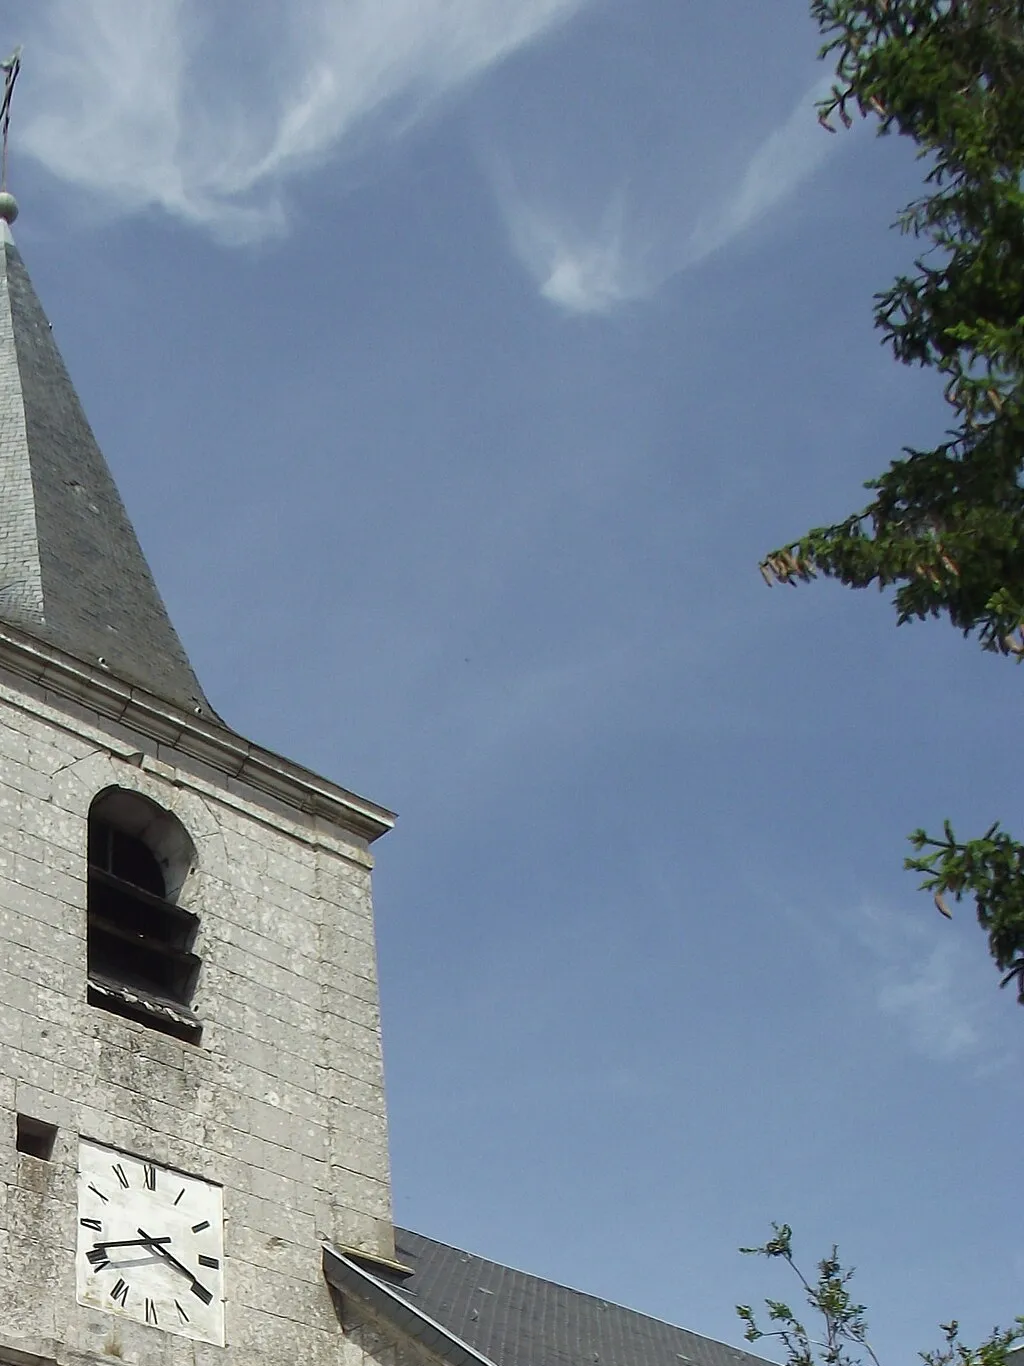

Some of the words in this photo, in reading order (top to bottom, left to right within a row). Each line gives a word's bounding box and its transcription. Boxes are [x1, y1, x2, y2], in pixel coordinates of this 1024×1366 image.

[87, 1181, 109, 1205] X
[173, 1188, 186, 1206] I
[173, 1298, 190, 1325] V
